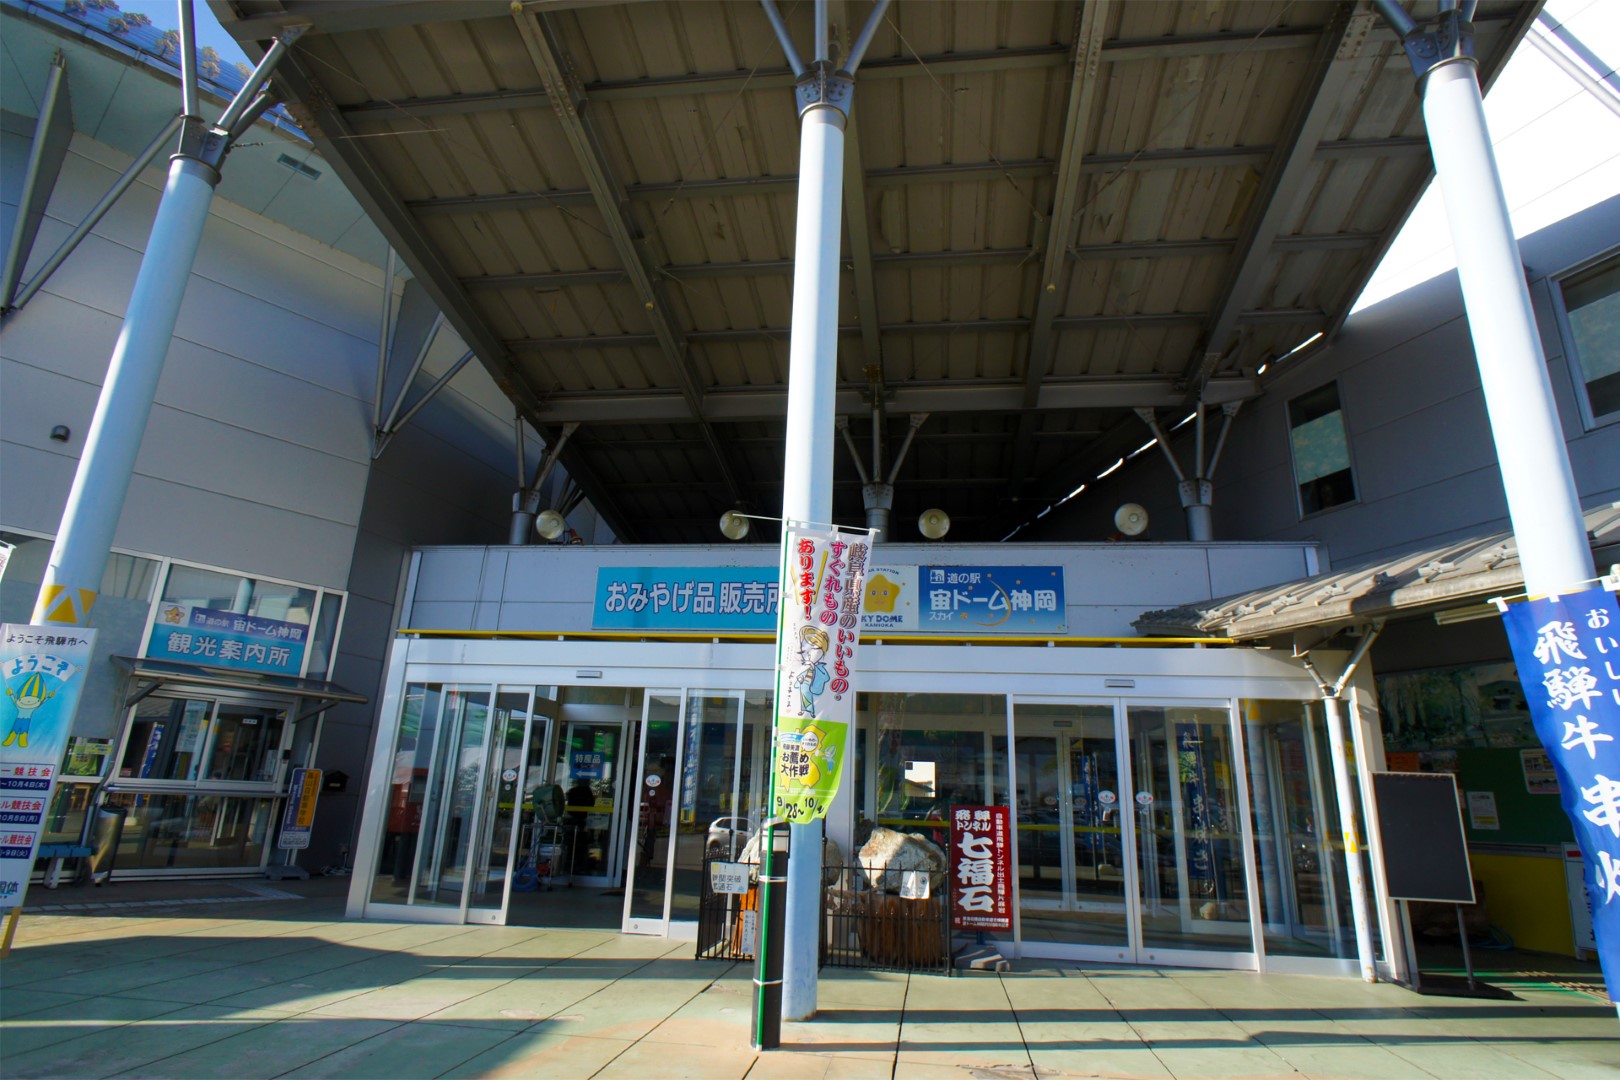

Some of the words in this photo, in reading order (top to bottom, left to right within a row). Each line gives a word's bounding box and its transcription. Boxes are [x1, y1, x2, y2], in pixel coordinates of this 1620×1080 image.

[820, 541, 847, 626] すぐれもの
[947, 572, 981, 584] 道の駅
[929, 588, 1056, 612] 宙ドーム神岡
[861, 615, 874, 623] KY
[876, 615, 904, 623] DOME
[929, 611, 954, 621] スカイ
[233, 619, 303, 640] 宙ドーム神岡
[167, 631, 291, 667] 観光案内所
[11, 655, 69, 676] ようこそ
[780, 764, 810, 778] 大作戦
[955, 809, 991, 820] 飛騨
[956, 820, 991, 831] トンネル
[957, 832, 994, 912] 七福石
